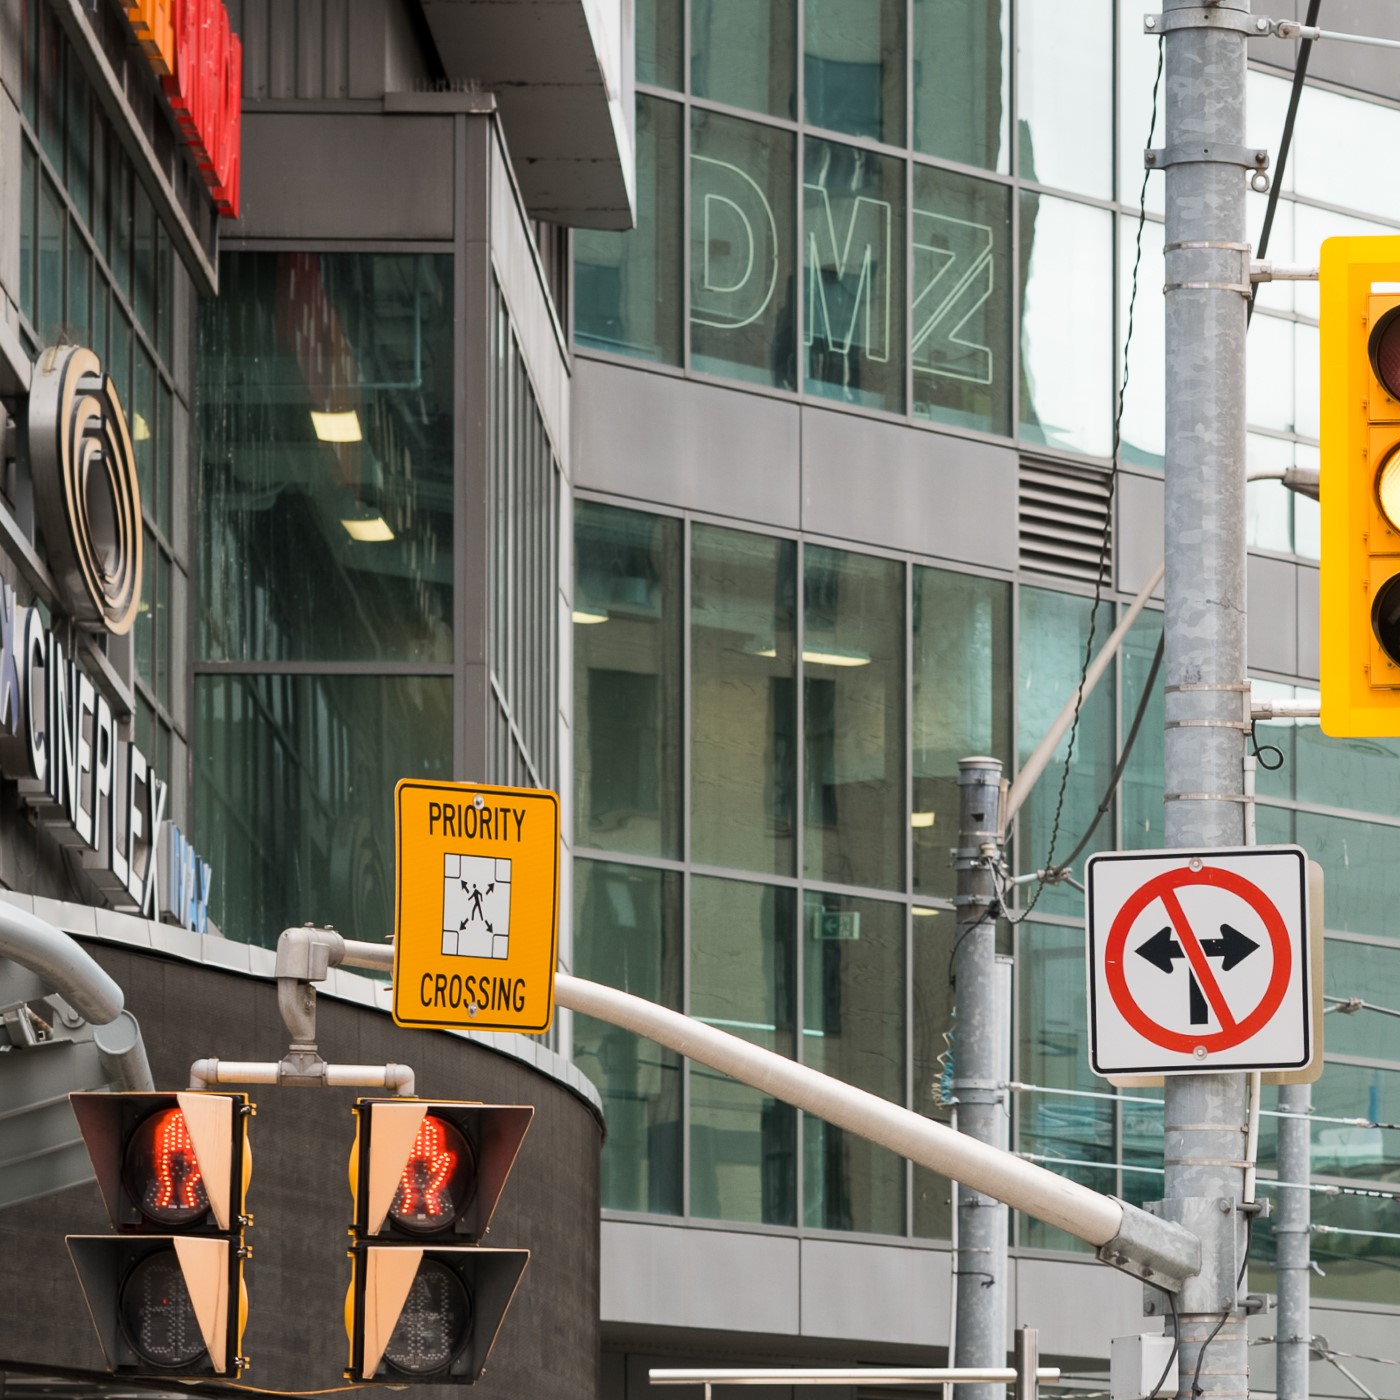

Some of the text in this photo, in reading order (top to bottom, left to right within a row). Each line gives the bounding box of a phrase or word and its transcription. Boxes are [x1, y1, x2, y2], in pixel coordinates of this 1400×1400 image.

[690, 155, 993, 384] DMZ
[24, 606, 167, 922] CINEPLEX
[428, 802, 527, 843] PRIORITY
[420, 972, 527, 1014] CROSSING
